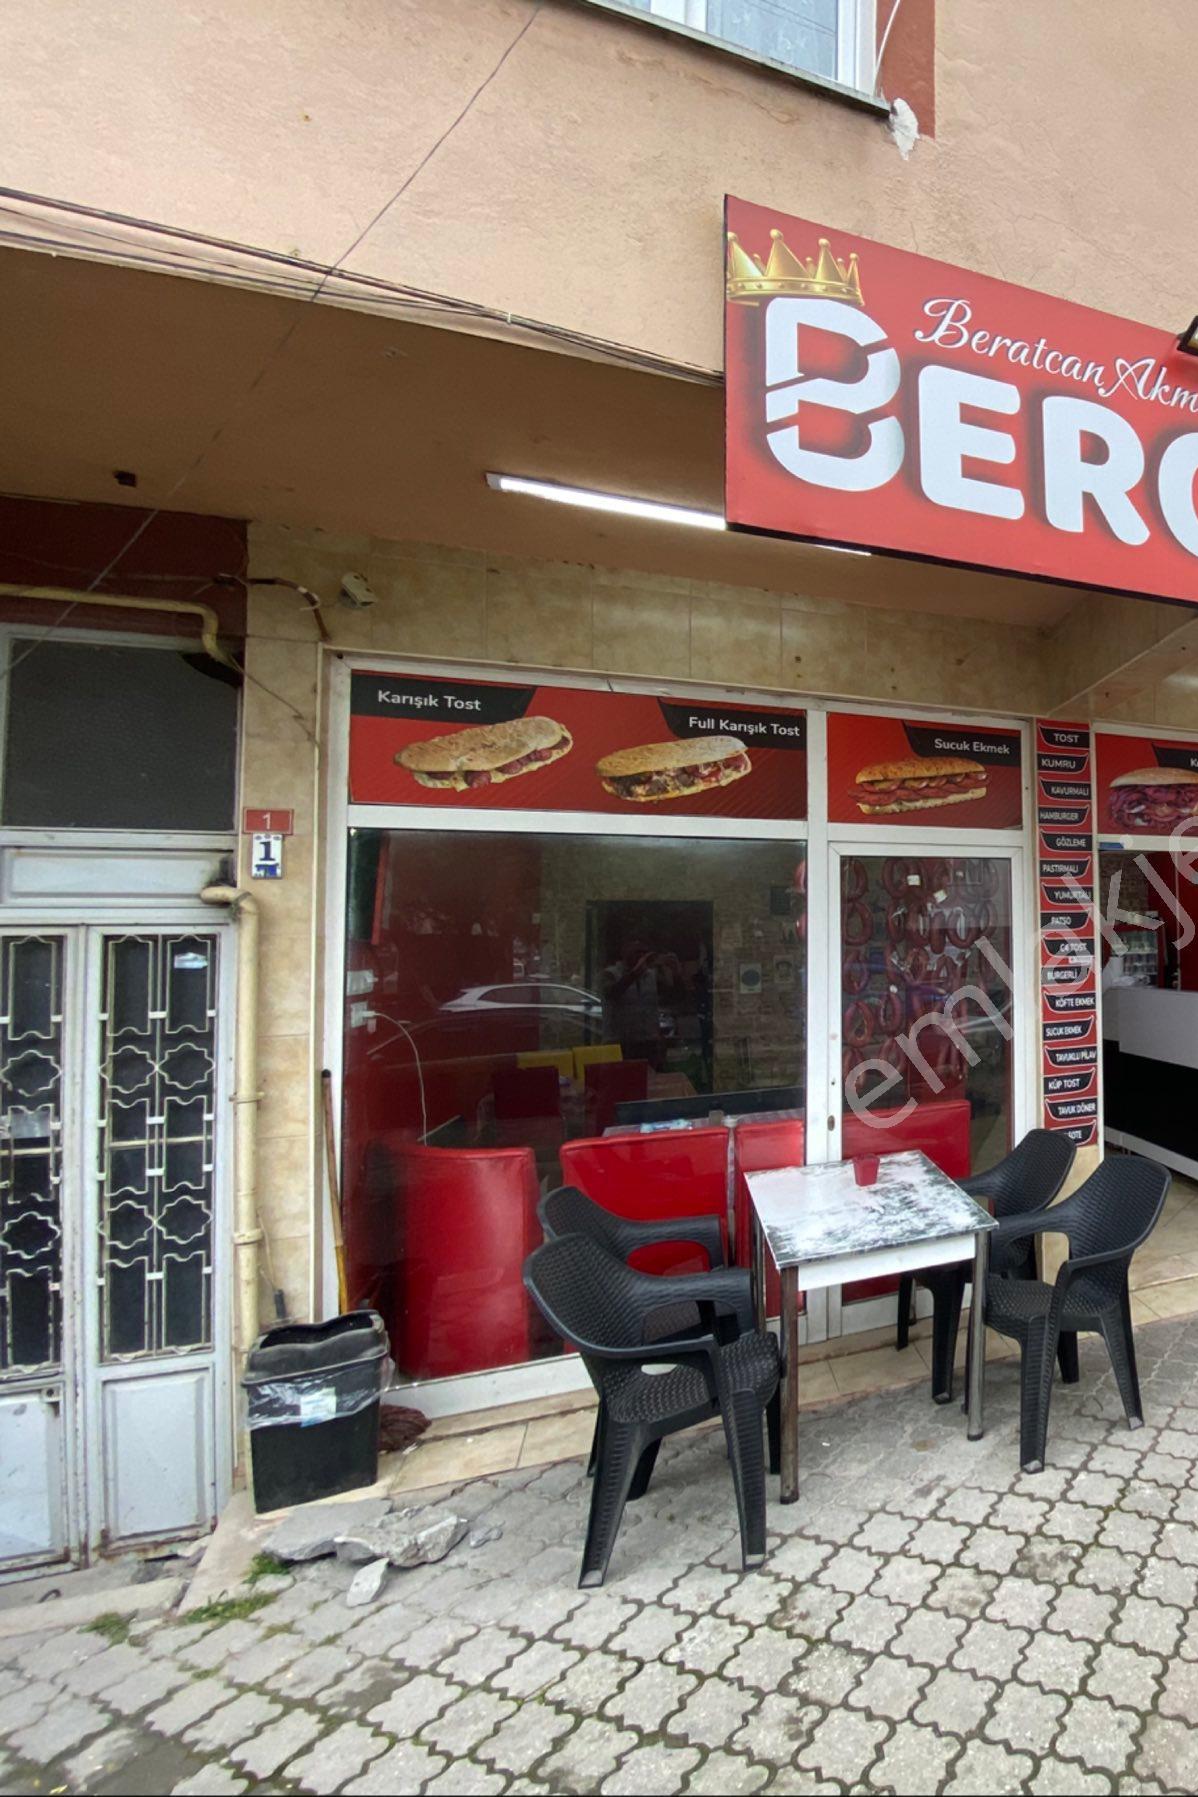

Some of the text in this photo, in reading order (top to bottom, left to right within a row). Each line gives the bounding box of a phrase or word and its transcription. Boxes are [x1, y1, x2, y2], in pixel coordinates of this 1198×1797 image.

[914, 298, 1105, 390] Beratcan
[377, 690, 482, 711] Karışık Tost
[689, 716, 800, 737] Full Karışık Tost
[934, 738, 1010, 755] Sucuk Ekmek
[1053, 733, 1080, 743] TOST
[1041, 758, 1077, 769] KUMRU
[262, 812, 271, 830] 1
[1040, 810, 1080, 821] HAMBURGER
[1056, 836, 1087, 848] GÖZLEME
[259, 841, 276, 861] 1
[1063, 1078, 1080, 1088] TOST
